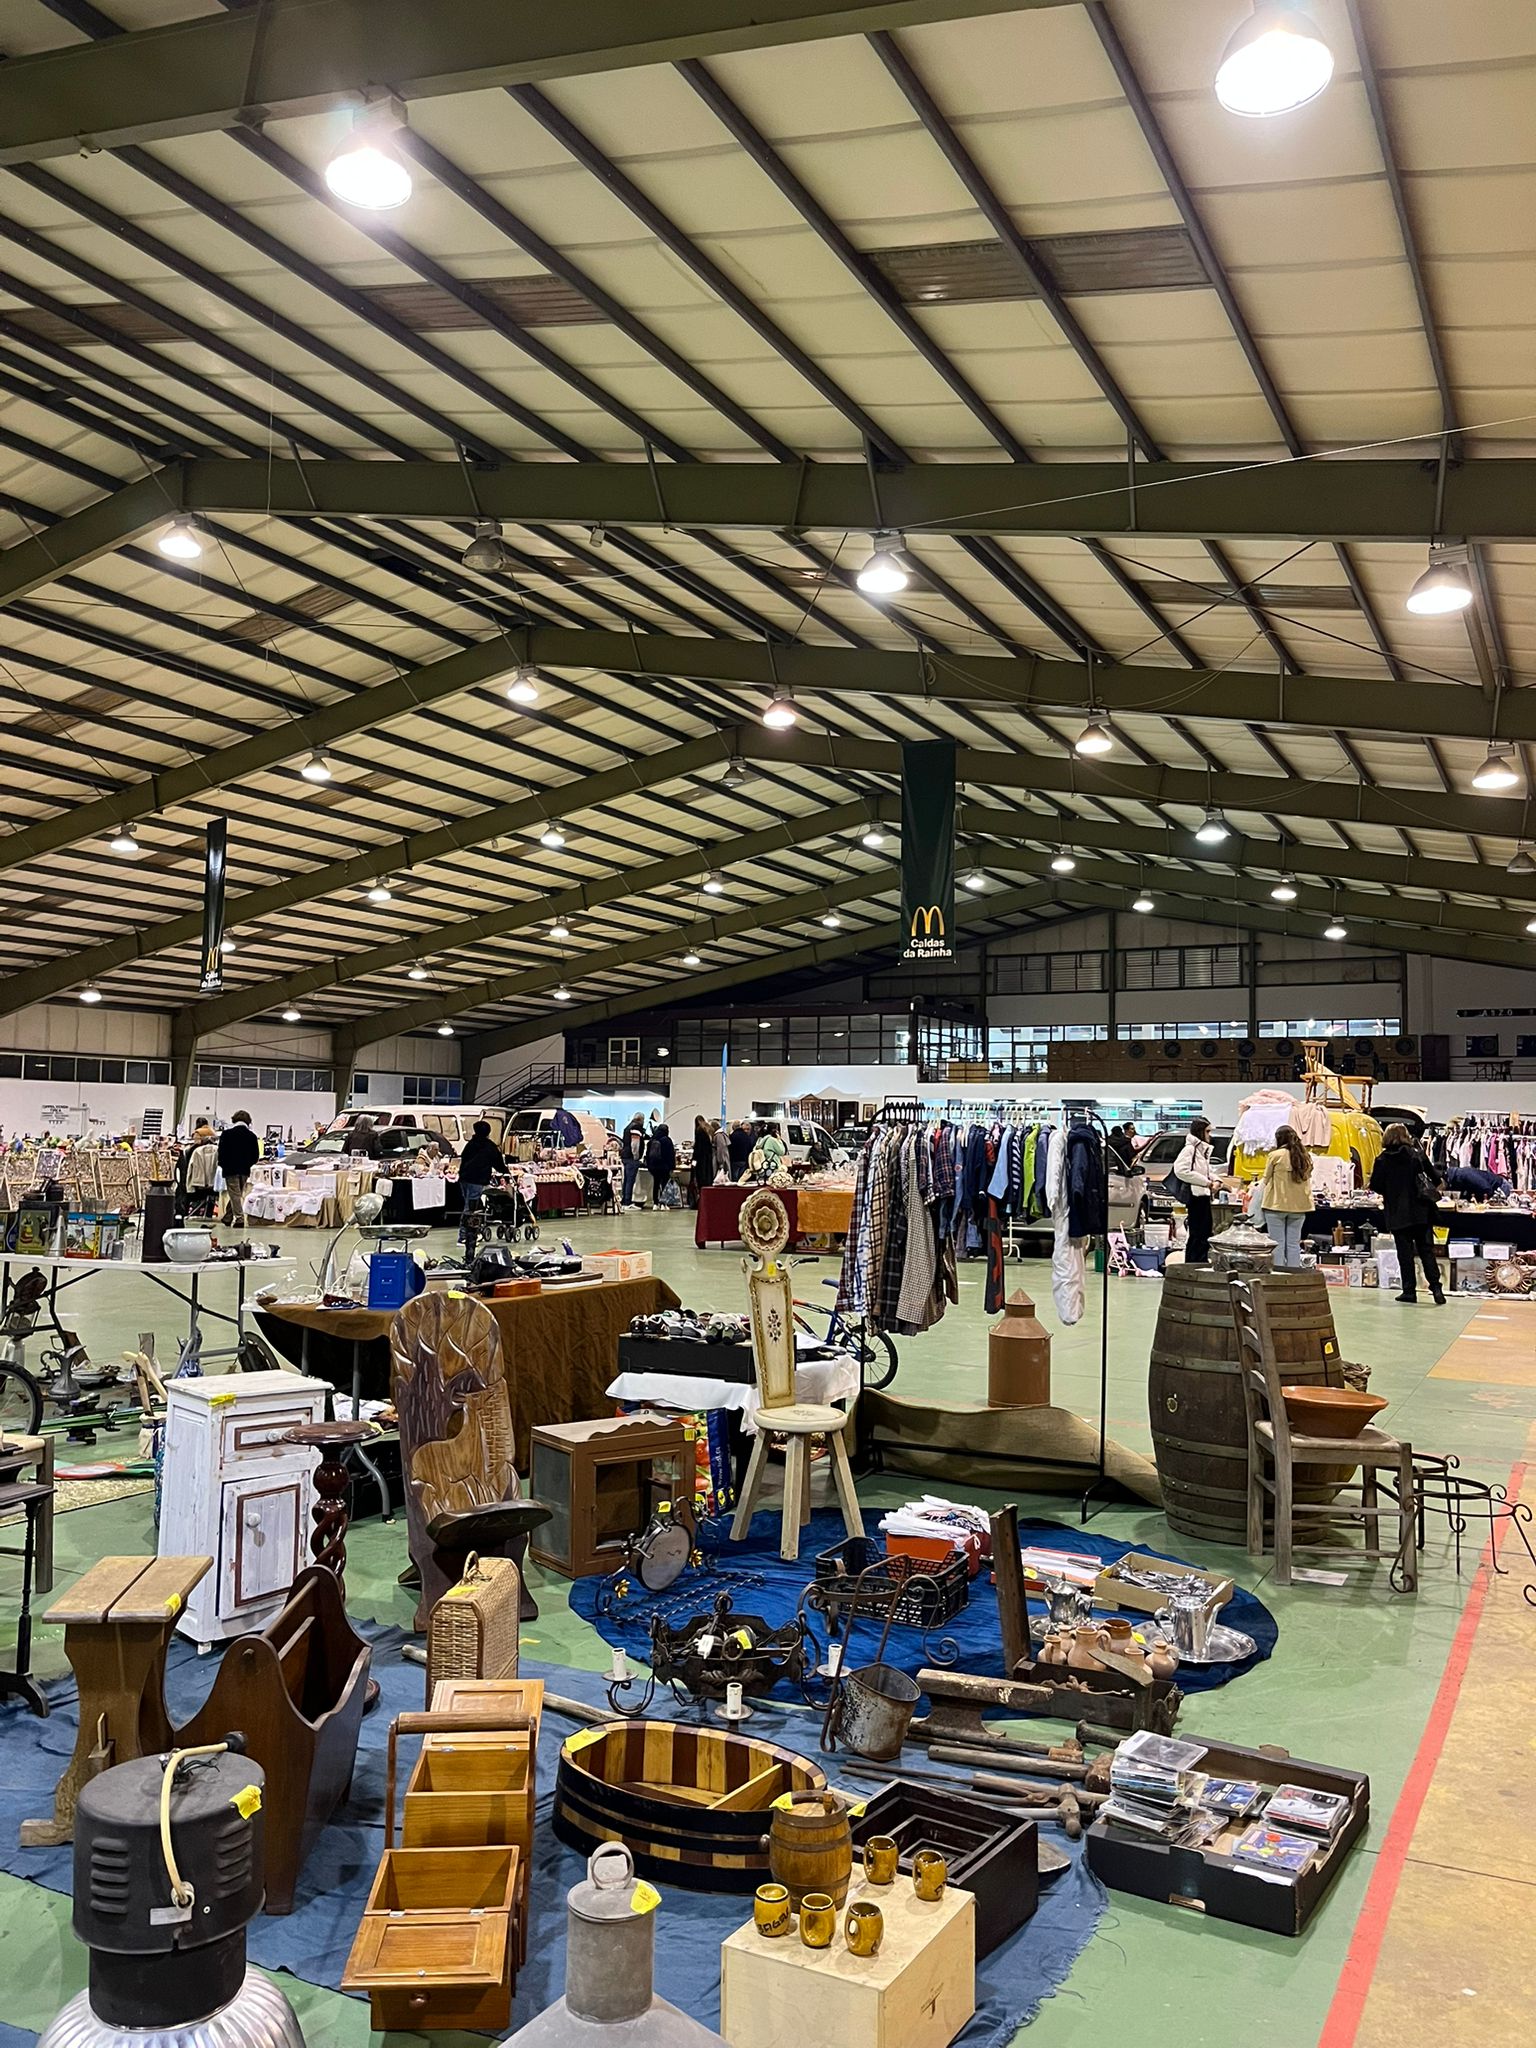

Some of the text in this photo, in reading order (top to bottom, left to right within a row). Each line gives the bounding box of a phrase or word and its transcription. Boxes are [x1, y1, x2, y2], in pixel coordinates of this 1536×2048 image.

[910, 938, 945, 947] Caldas
[903, 948, 952, 958] da Rainha
